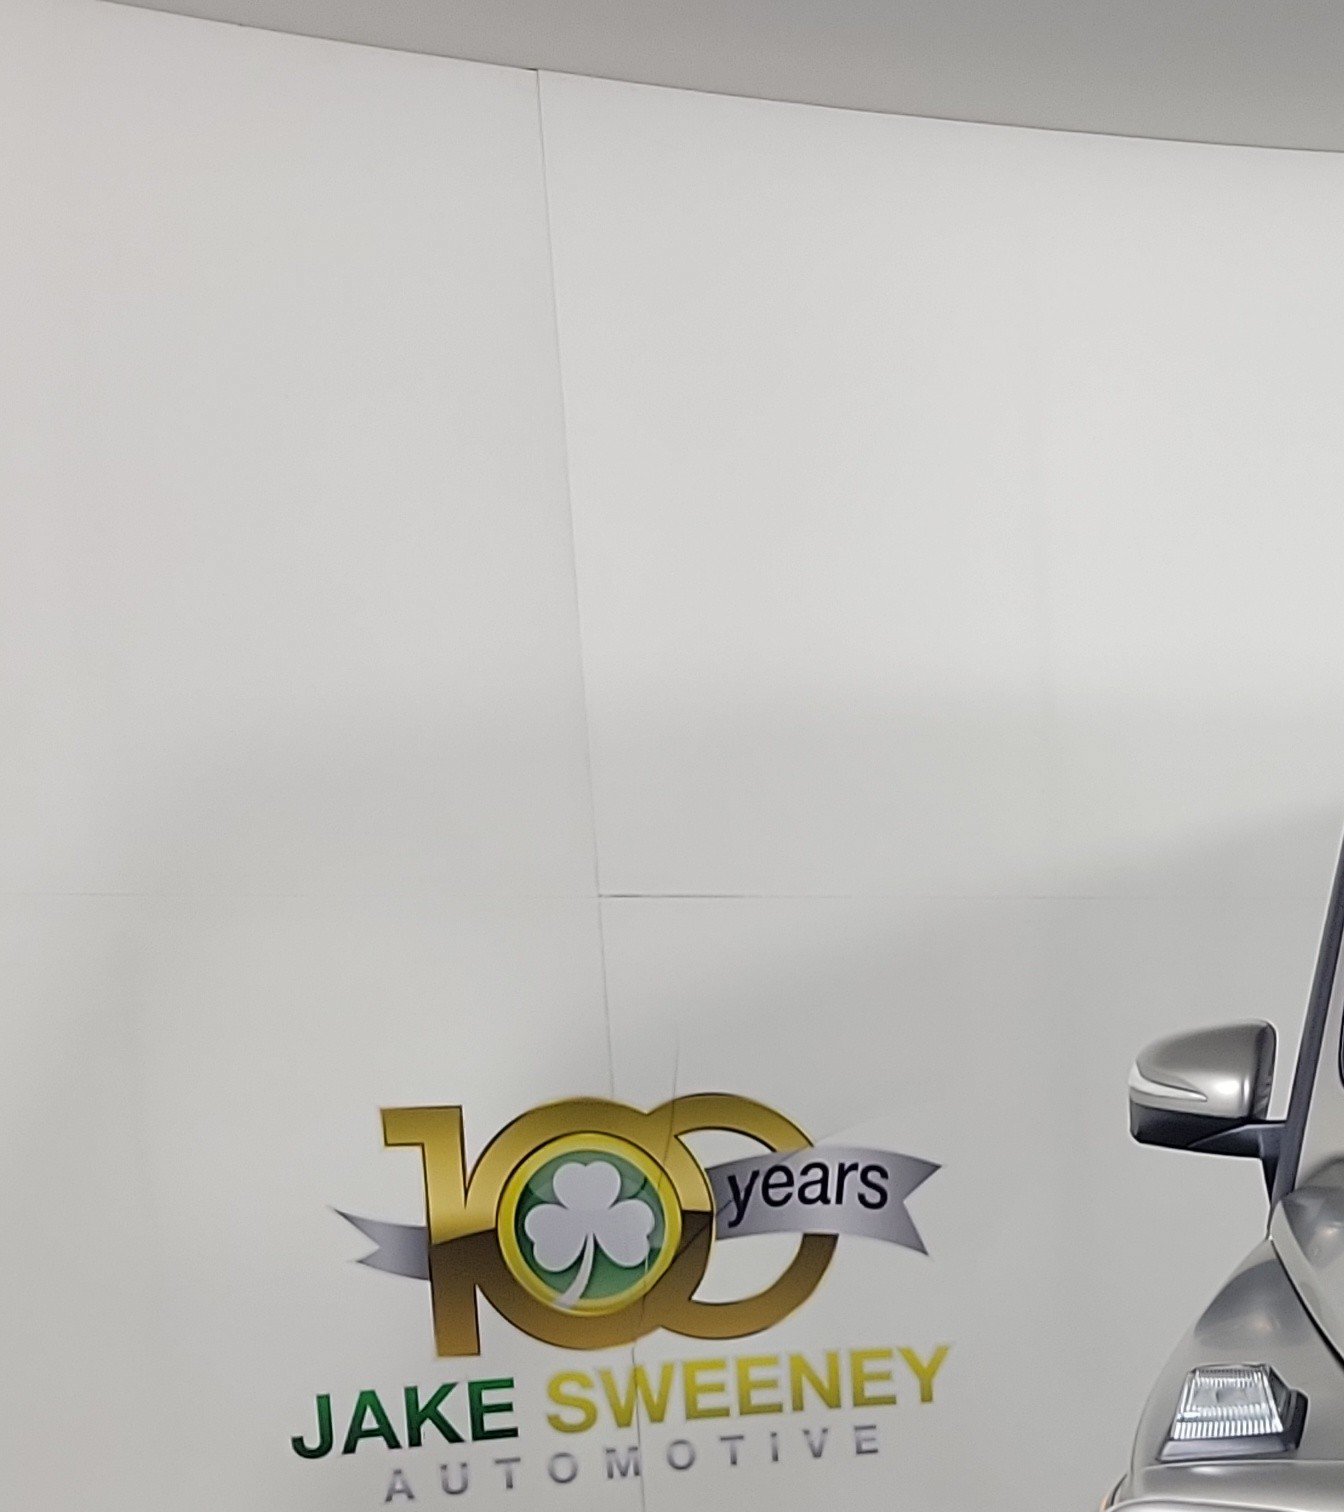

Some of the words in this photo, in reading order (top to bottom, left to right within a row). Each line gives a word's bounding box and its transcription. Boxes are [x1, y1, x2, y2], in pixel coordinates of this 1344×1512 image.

[379, 1091, 839, 1357] 100
[727, 1159, 890, 1228] years
[290, 1376, 520, 1460] JAKE
[545, 1344, 951, 1435] SWEENEY
[383, 1424, 881, 1503] AUTOMOTIVE
